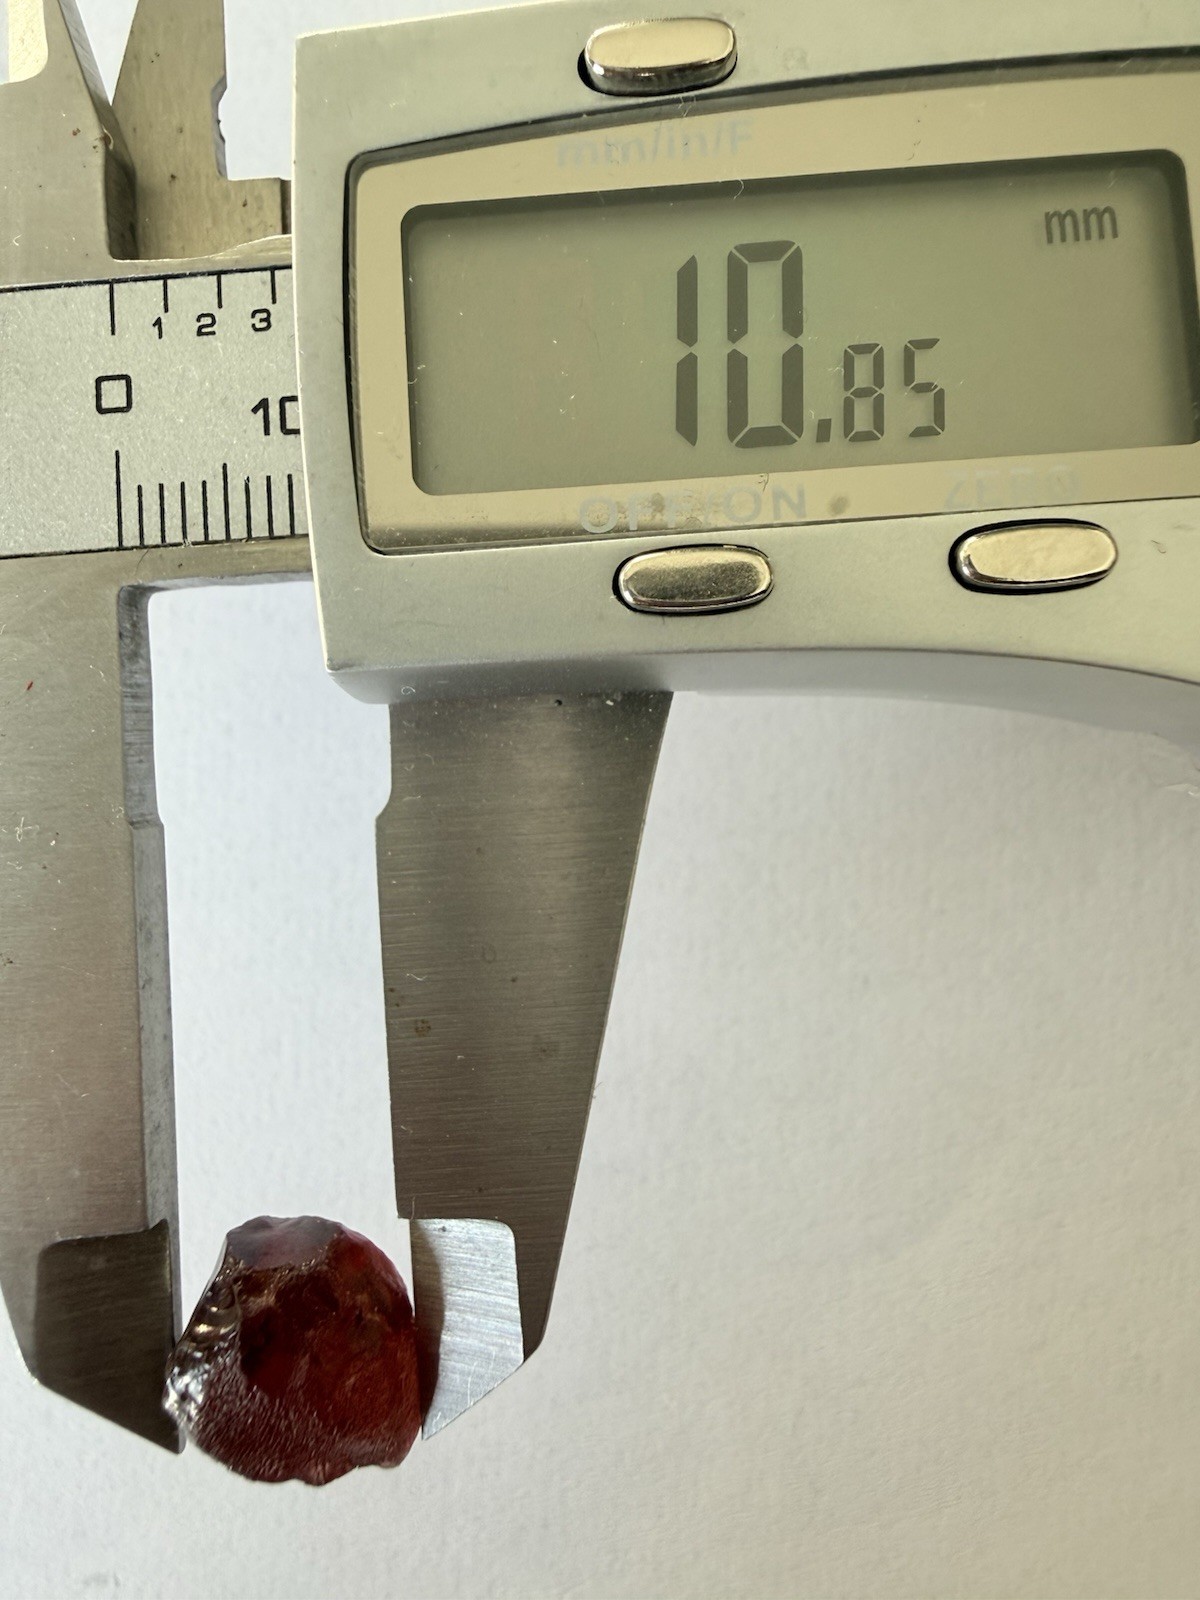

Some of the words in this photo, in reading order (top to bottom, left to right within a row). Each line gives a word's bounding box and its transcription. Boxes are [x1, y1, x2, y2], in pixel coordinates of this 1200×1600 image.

[1045, 205, 1119, 244] mm
[152, 316, 163, 339] 1
[196, 312, 217, 337] 2
[250, 308, 272, 332] 3
[675, 240, 946, 449] 10.85
